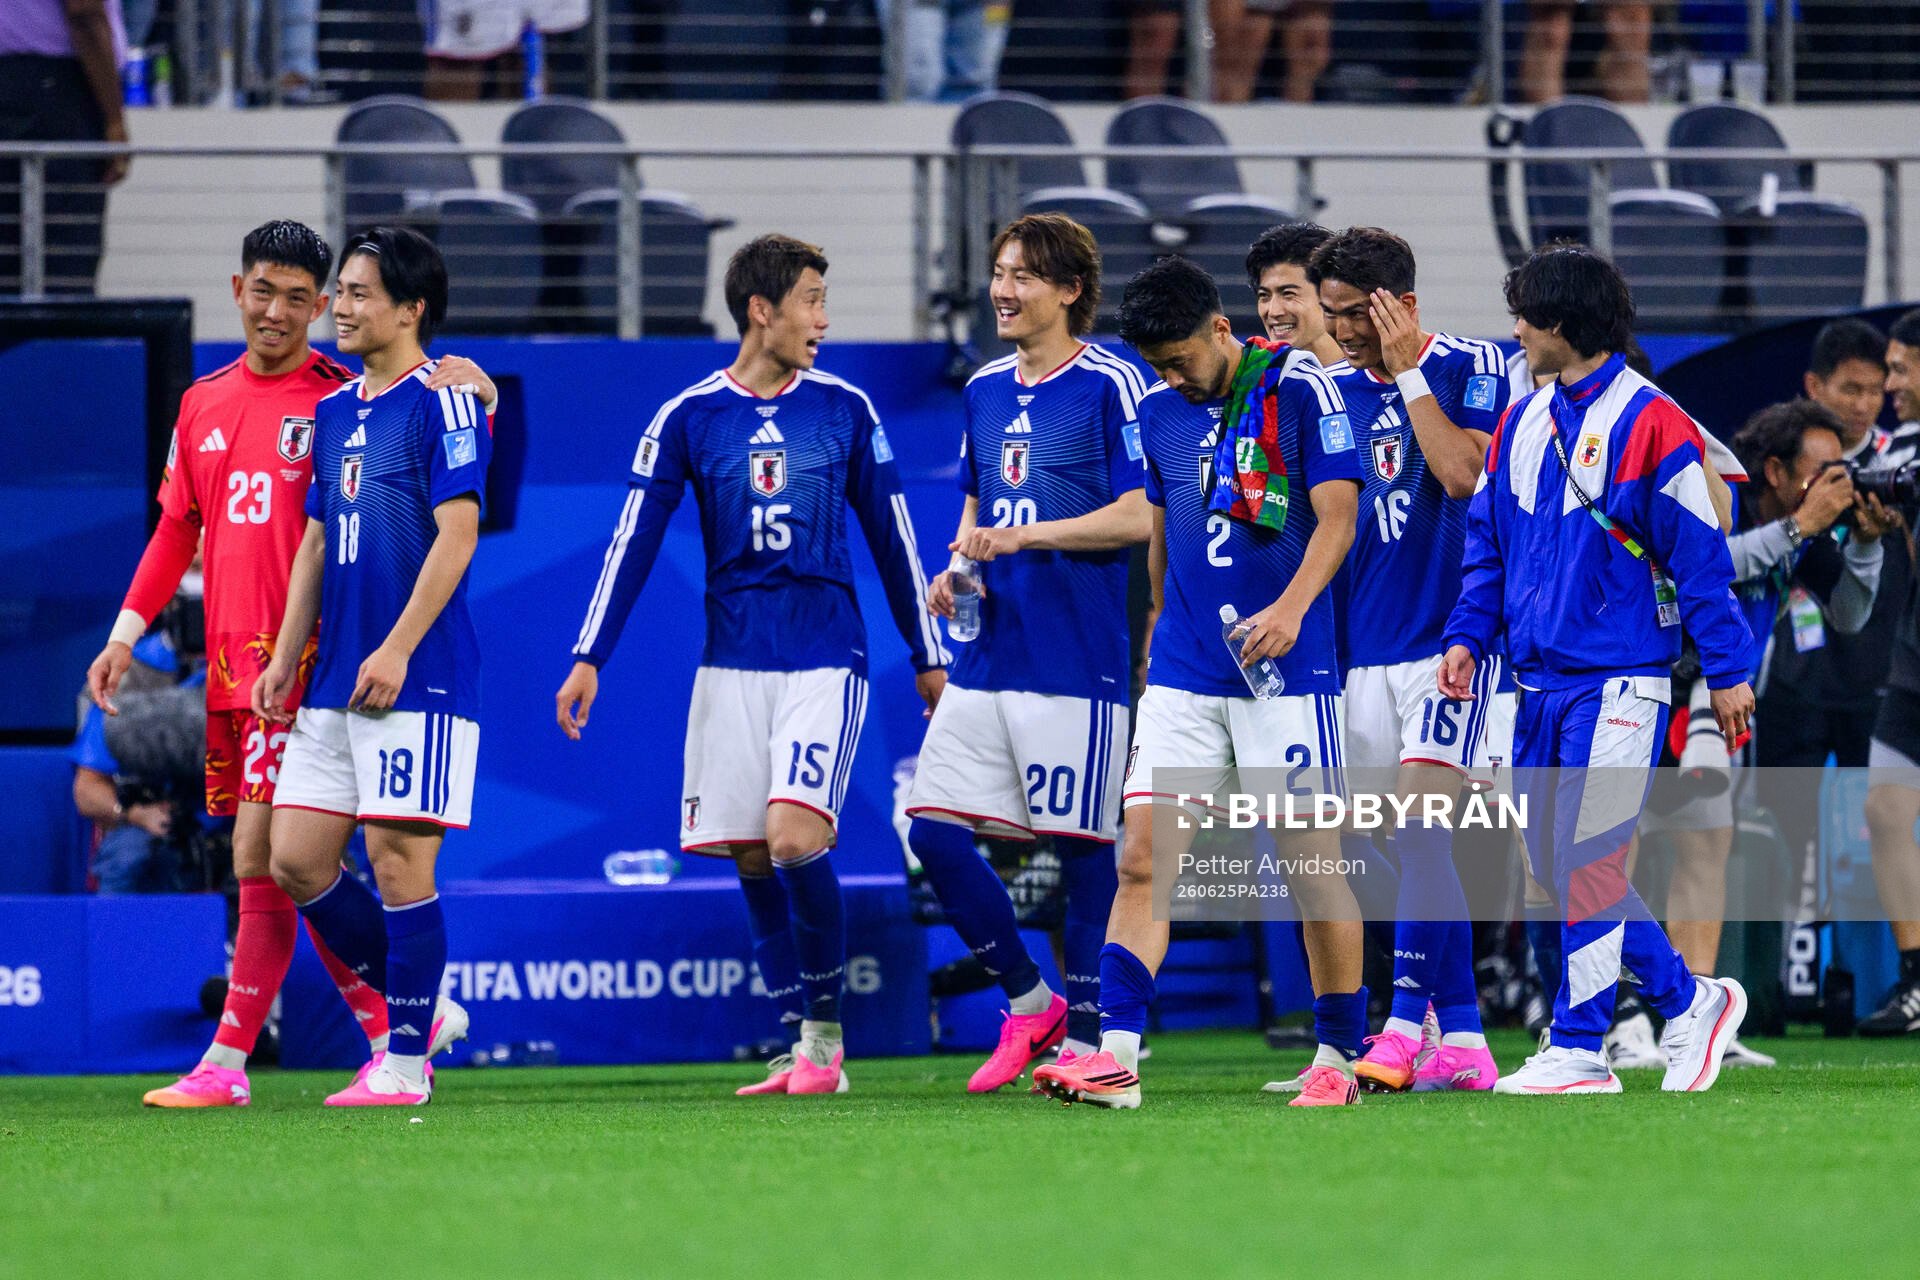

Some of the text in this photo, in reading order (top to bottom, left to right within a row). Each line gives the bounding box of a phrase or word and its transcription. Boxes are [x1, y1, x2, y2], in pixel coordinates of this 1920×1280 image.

[227, 470, 272, 524] 23
[992, 498, 1037, 528] 20
[1244, 488, 1264, 500] CUP
[1374, 490, 1411, 543] 16
[338, 512, 360, 565] 18
[752, 504, 792, 551] 15
[1206, 514, 1233, 567] 2
[1419, 696, 1462, 747] 16
[1607, 718, 1631, 727] adidas
[244, 731, 288, 784] 23
[379, 748, 413, 799] 18
[787, 740, 830, 789] 15
[1285, 743, 1312, 796] 2
[1026, 763, 1076, 816] 20
[441, 960, 522, 1001] FIFA
[524, 960, 663, 1000] WORLD
[669, 958, 744, 998] CUP
